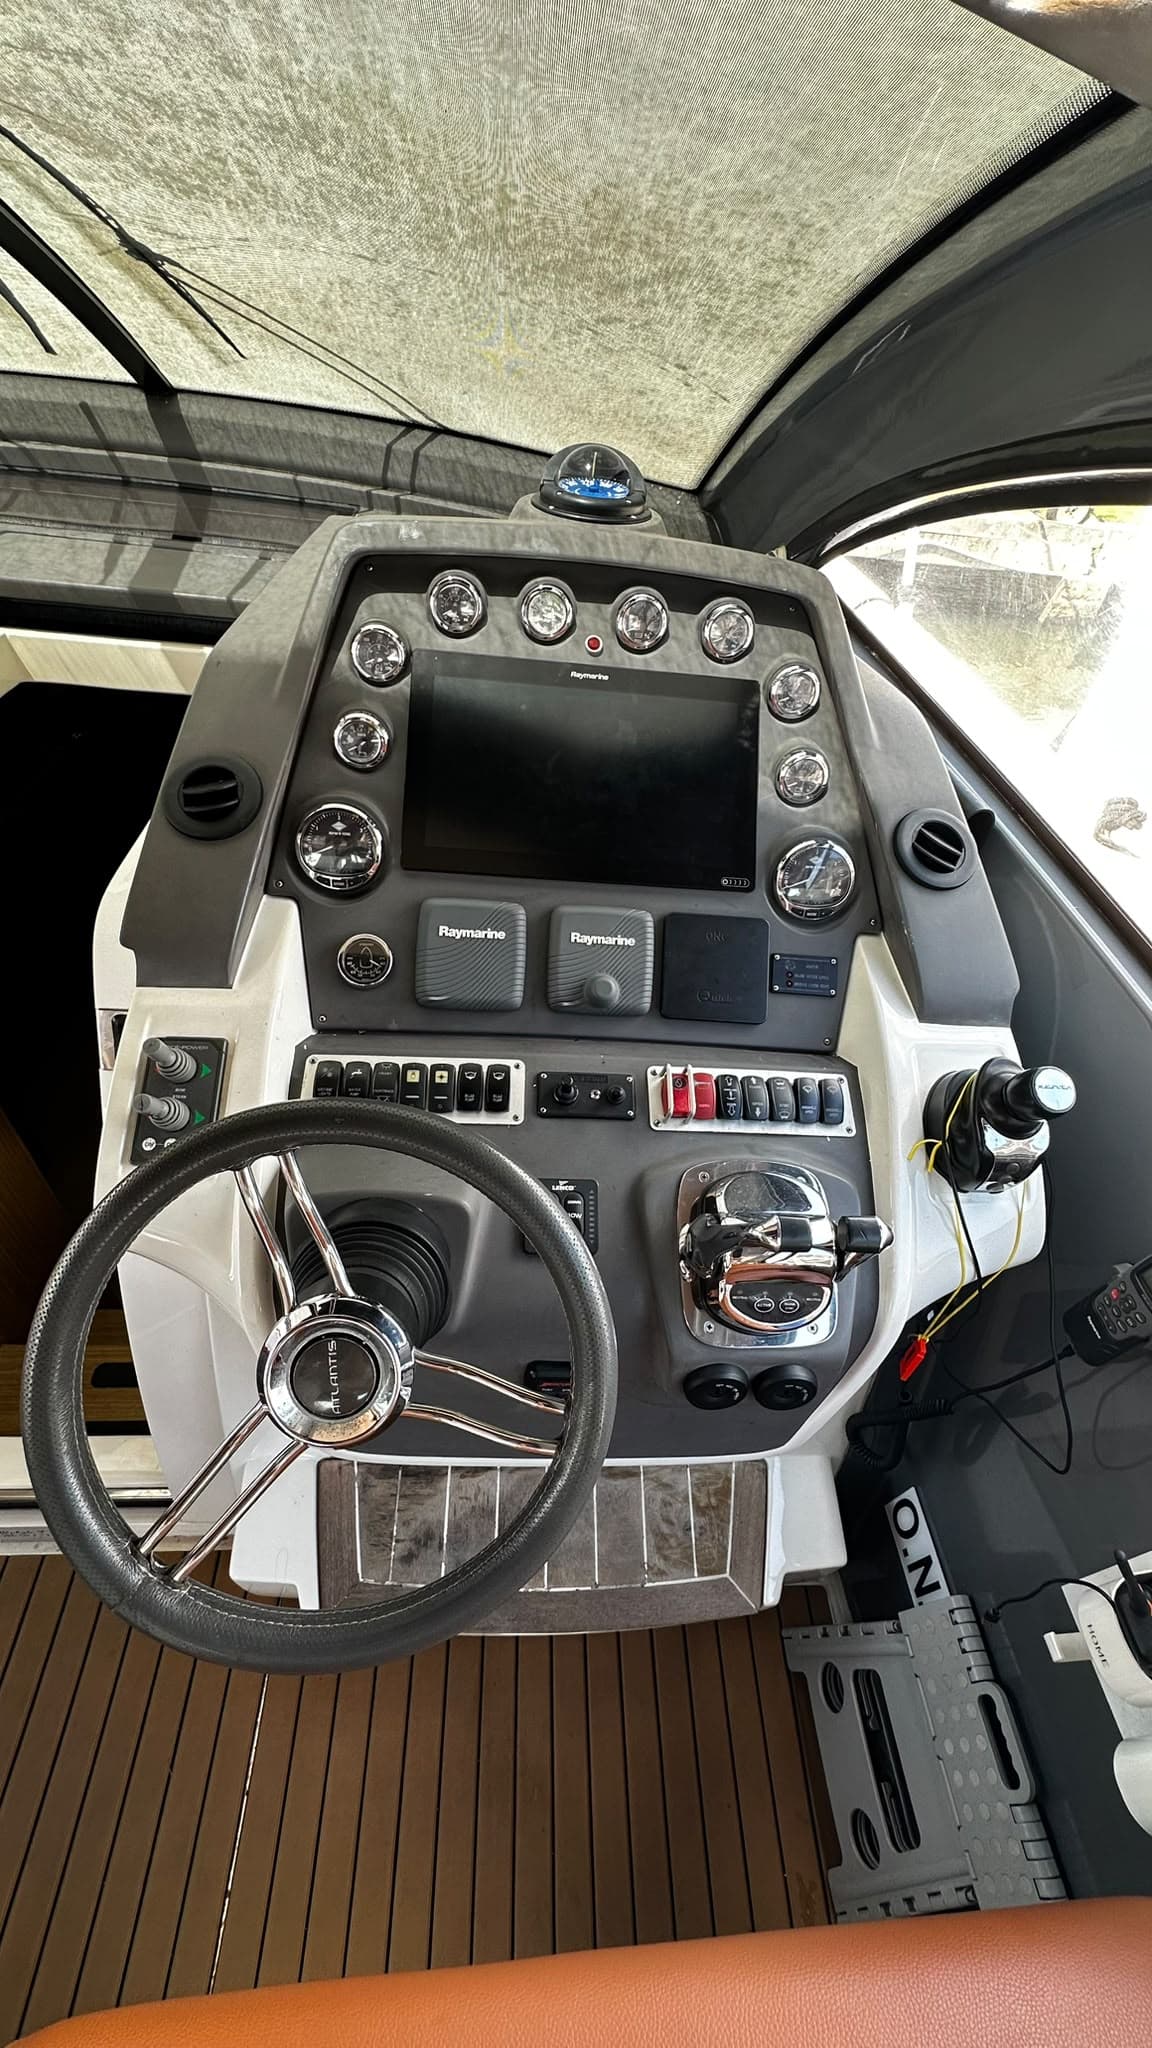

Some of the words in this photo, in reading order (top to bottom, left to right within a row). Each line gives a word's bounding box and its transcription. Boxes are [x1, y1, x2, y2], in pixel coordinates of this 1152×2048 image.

[570, 670, 609, 680] Raymarine
[438, 925, 506, 940] Raymarine
[570, 931, 636, 946] Raymarine
[327, 1338, 342, 1415] ATLANTIS
[1087, 1623, 1111, 1669] HOME
